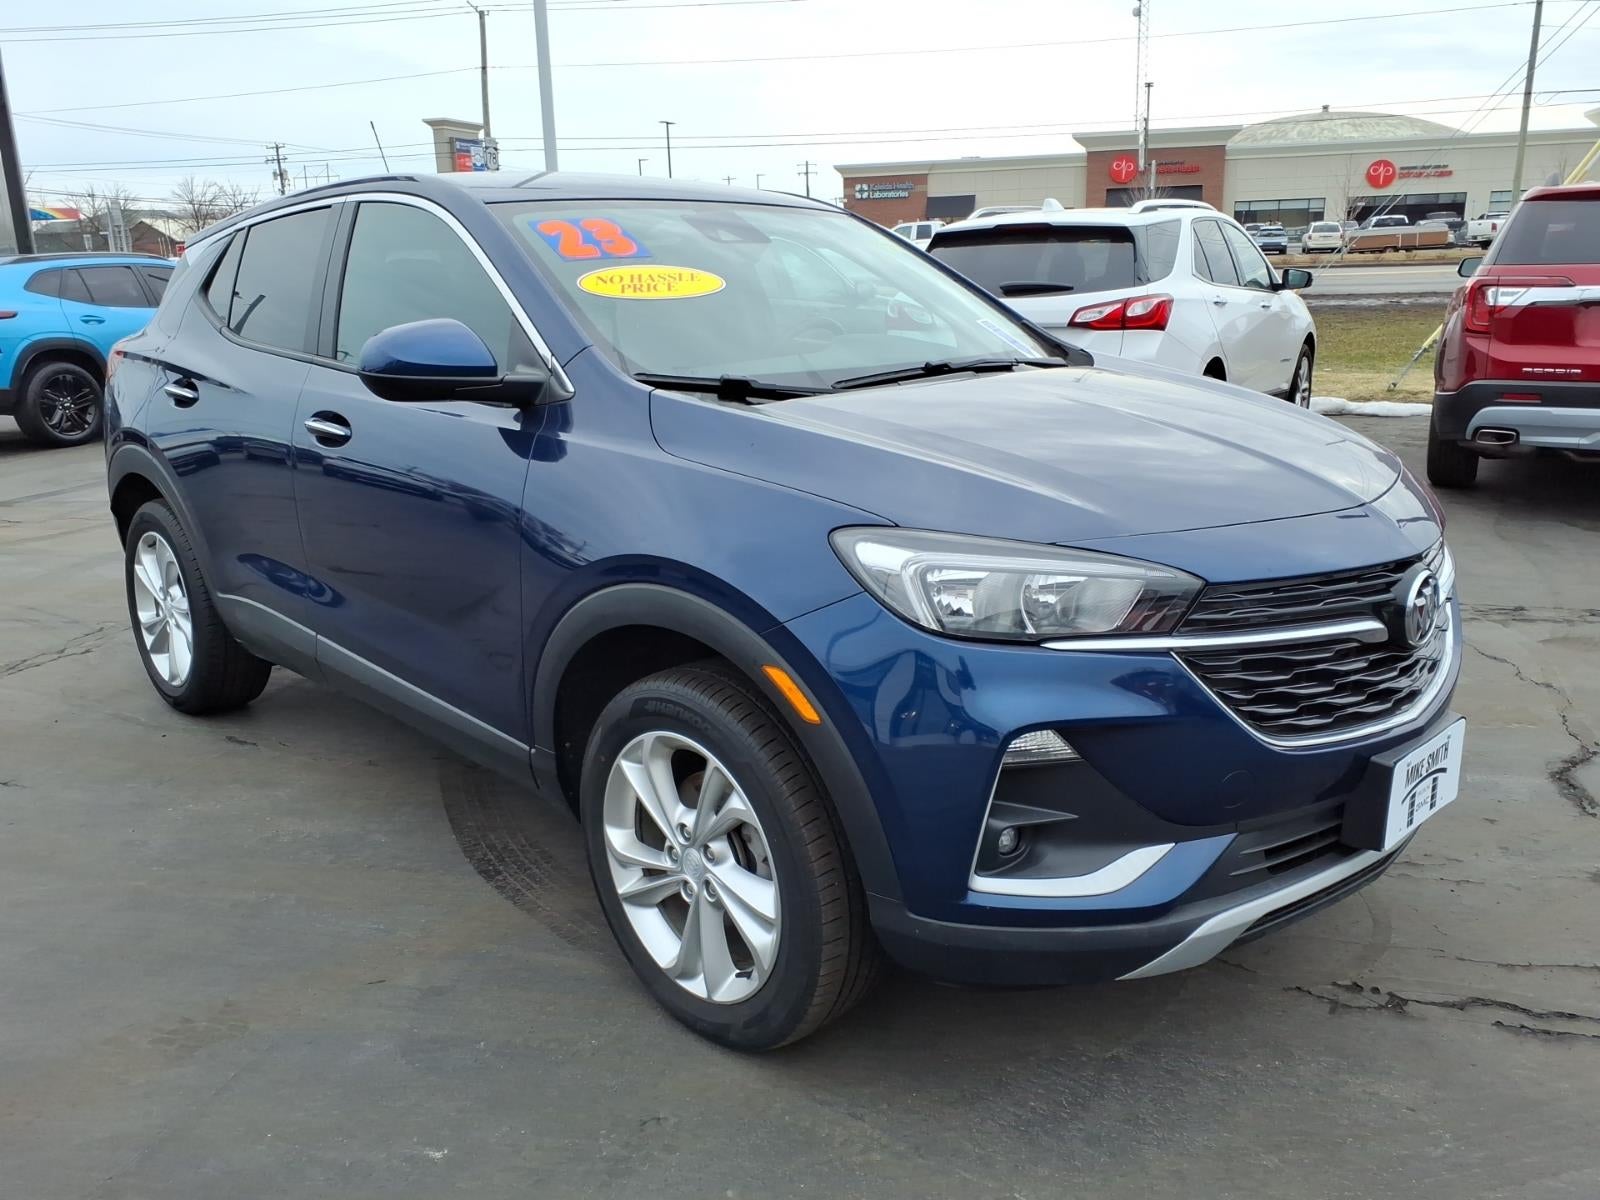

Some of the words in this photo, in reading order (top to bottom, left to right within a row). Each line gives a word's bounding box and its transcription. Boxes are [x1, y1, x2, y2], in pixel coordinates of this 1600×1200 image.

[869, 190, 909, 199] Laboratories
[537, 217, 638, 260] 23
[595, 274, 624, 287] NO
[629, 271, 701, 285] HASSLE
[620, 282, 678, 295] PRICE
[1405, 757, 1426, 789] MIKE
[1425, 740, 1450, 774] SMITH
